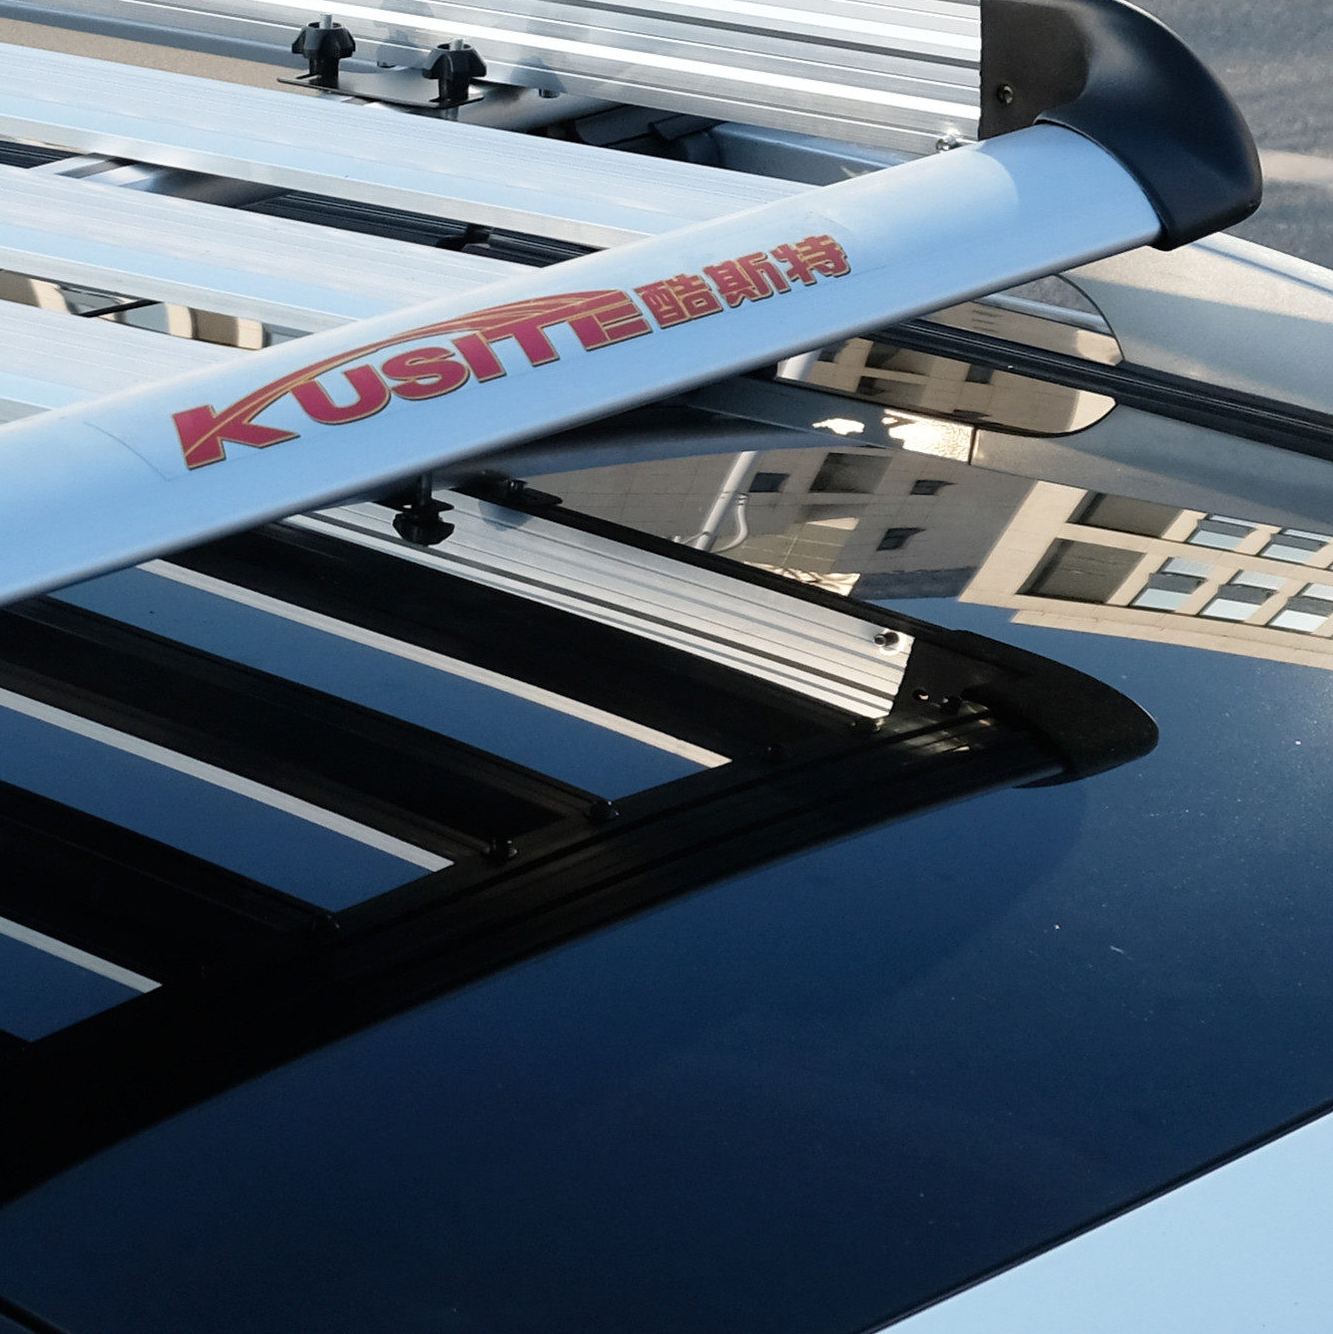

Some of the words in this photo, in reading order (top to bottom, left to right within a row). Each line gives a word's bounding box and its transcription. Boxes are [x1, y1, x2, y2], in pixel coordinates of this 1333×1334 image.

[171, 289, 654, 471] KUSITE
[633, 234, 851, 330] 酷斯特
